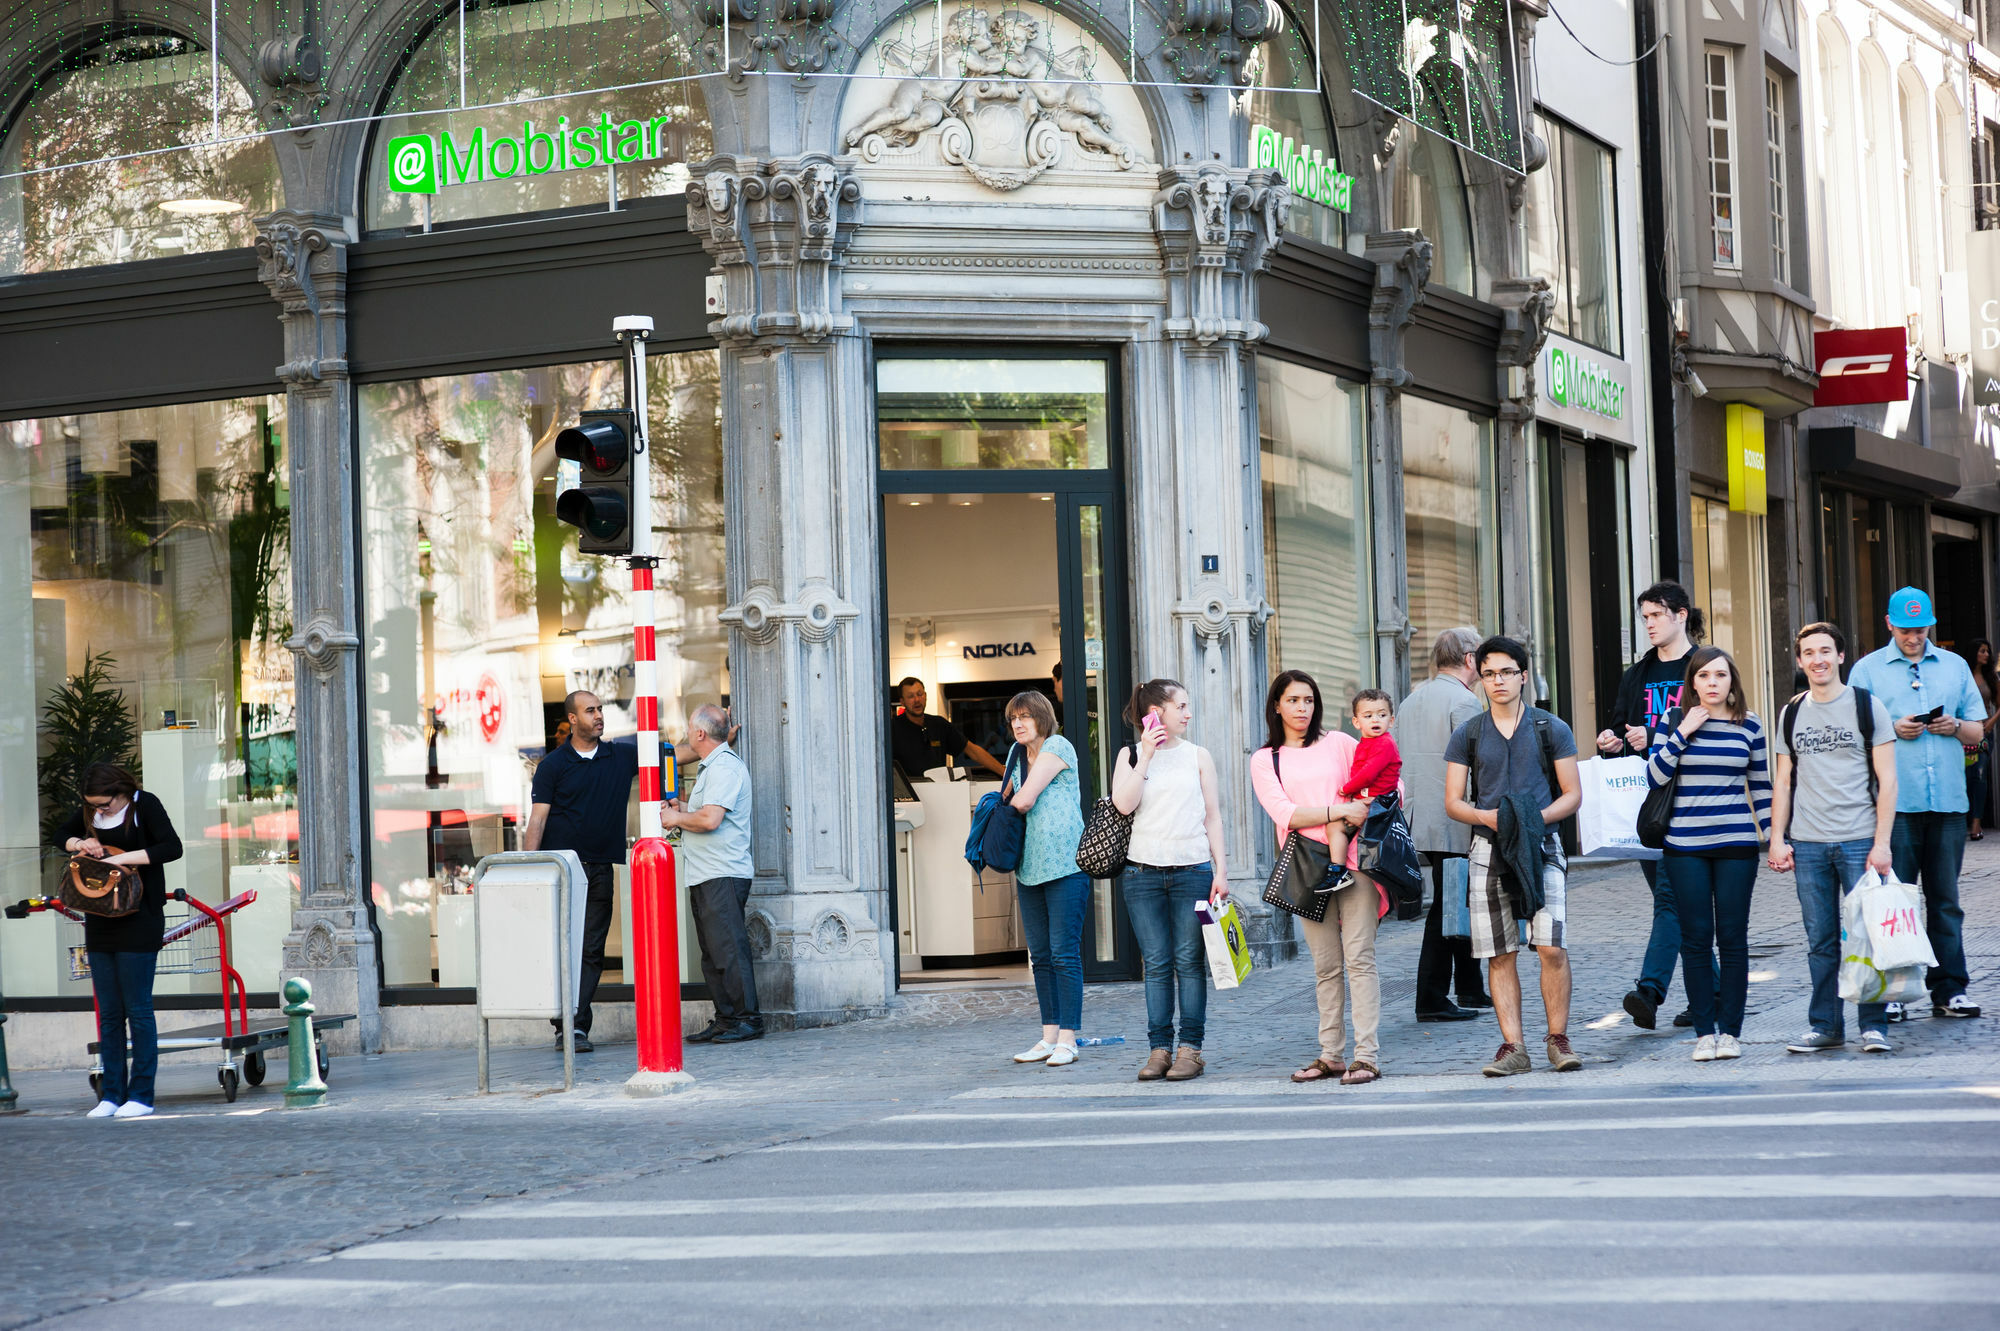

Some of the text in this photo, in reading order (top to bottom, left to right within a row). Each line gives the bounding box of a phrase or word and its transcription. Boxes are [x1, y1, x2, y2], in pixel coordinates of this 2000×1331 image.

[1207, 558, 1213, 570] 1
[963, 641, 1036, 660] NOKIA
[1796, 732, 1832, 749] Florida
[1606, 775, 1648, 788] MEPHIS
